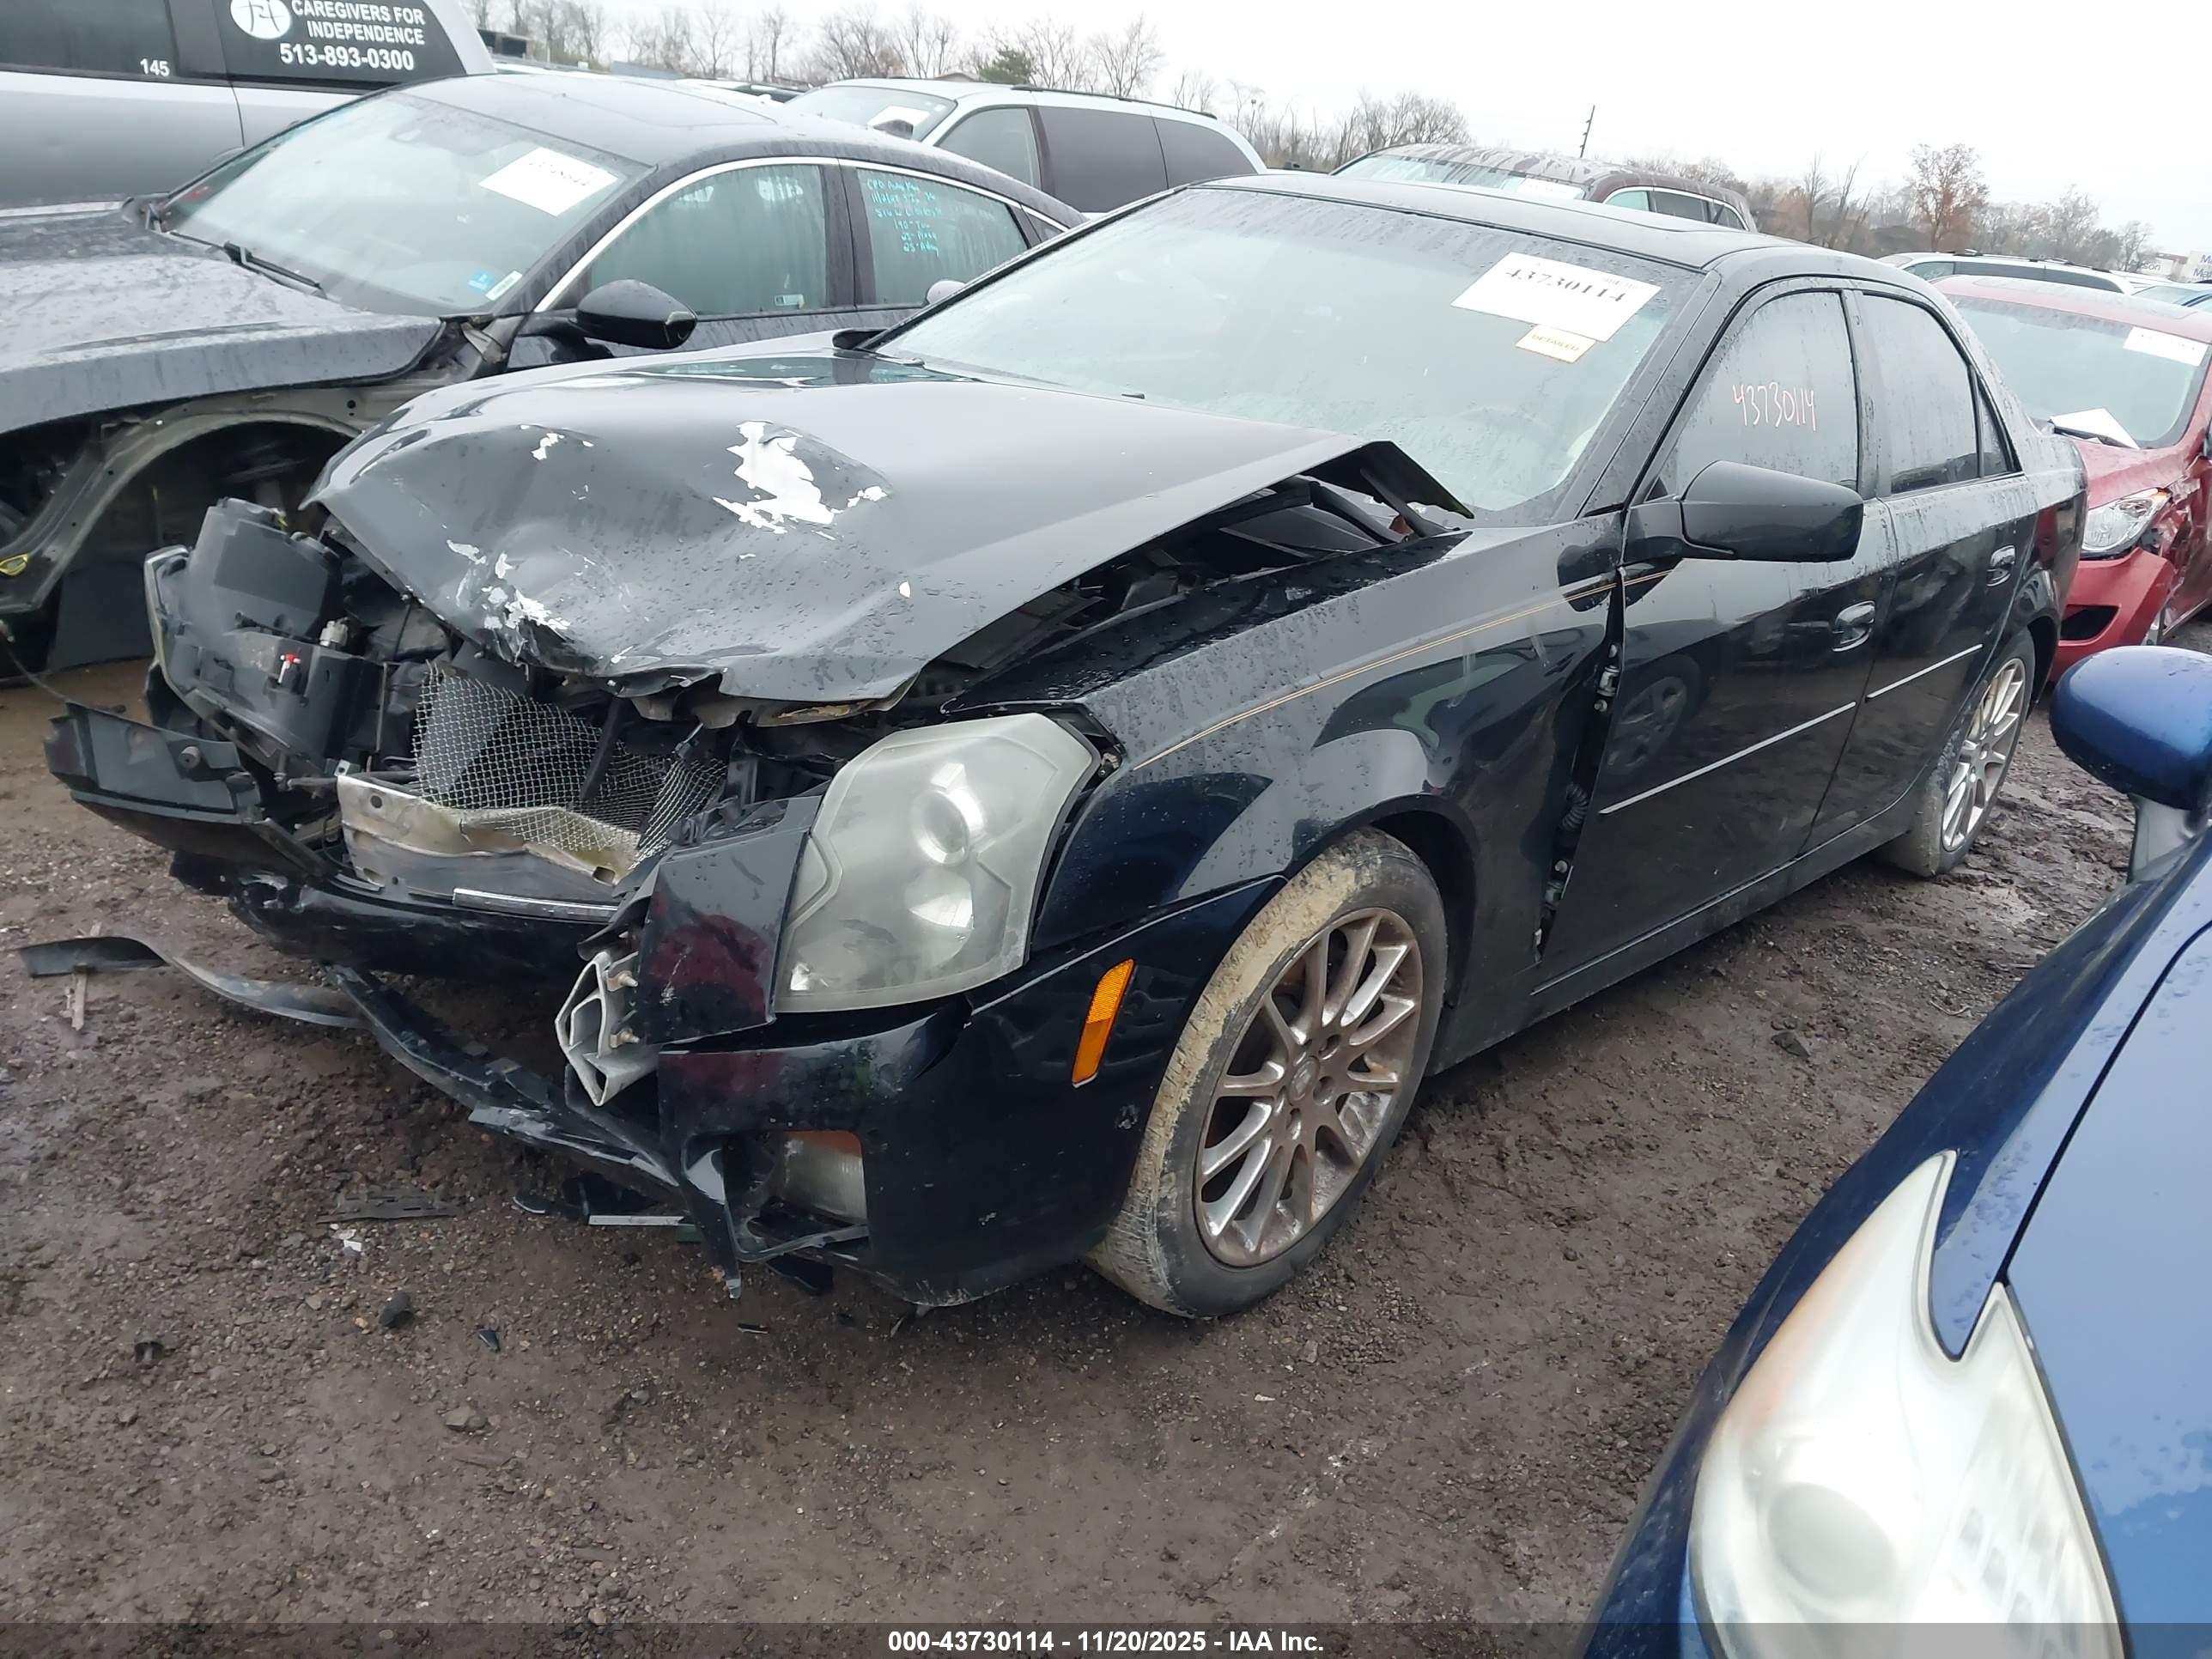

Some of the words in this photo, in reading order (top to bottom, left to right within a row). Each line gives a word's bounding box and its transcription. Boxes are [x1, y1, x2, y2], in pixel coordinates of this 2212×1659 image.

[291, 0, 392, 23] CAREGIVERS
[392, 6, 426, 26] FOR
[307, 20, 426, 46] INDEPENDENCE
[140, 58, 171, 77] 145
[280, 42, 415, 71] 513-893-0300
[1504, 268, 1626, 302] 43730114
[1732, 381, 1817, 431] 43730114
